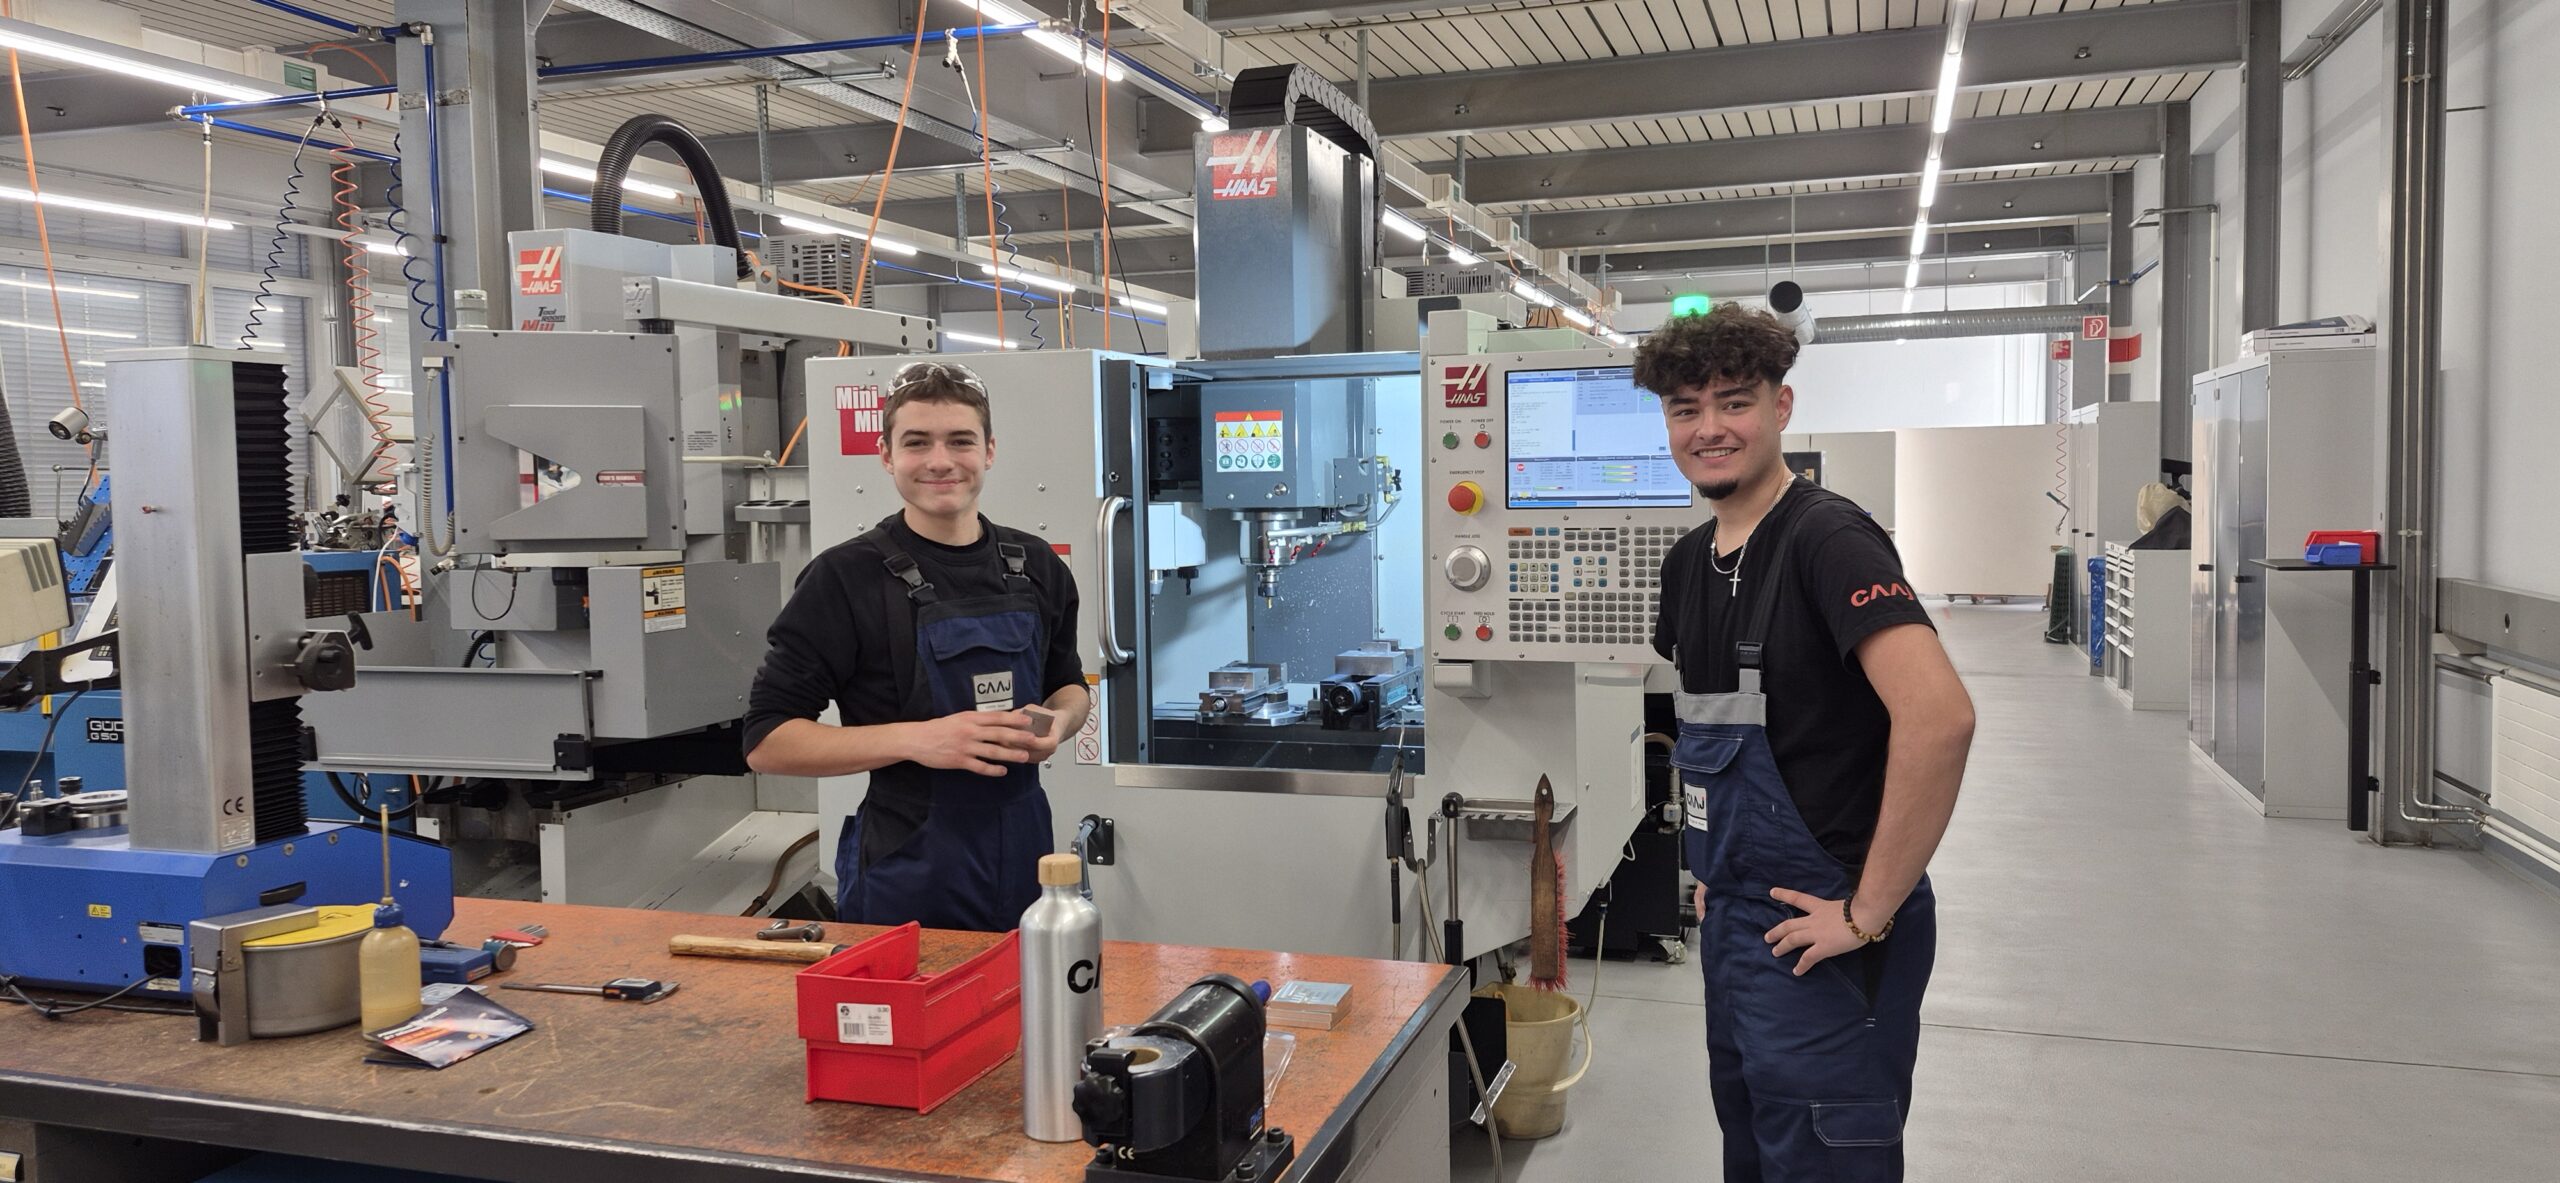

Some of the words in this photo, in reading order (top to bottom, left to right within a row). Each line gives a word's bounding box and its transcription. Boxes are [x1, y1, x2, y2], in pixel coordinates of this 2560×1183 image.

[1213, 176, 1277, 197] HAAS
[521, 279, 562, 294] HAAS
[835, 385, 878, 410] Mini
[1446, 392, 1485, 405] HAAS
[854, 409, 884, 433] Mil
